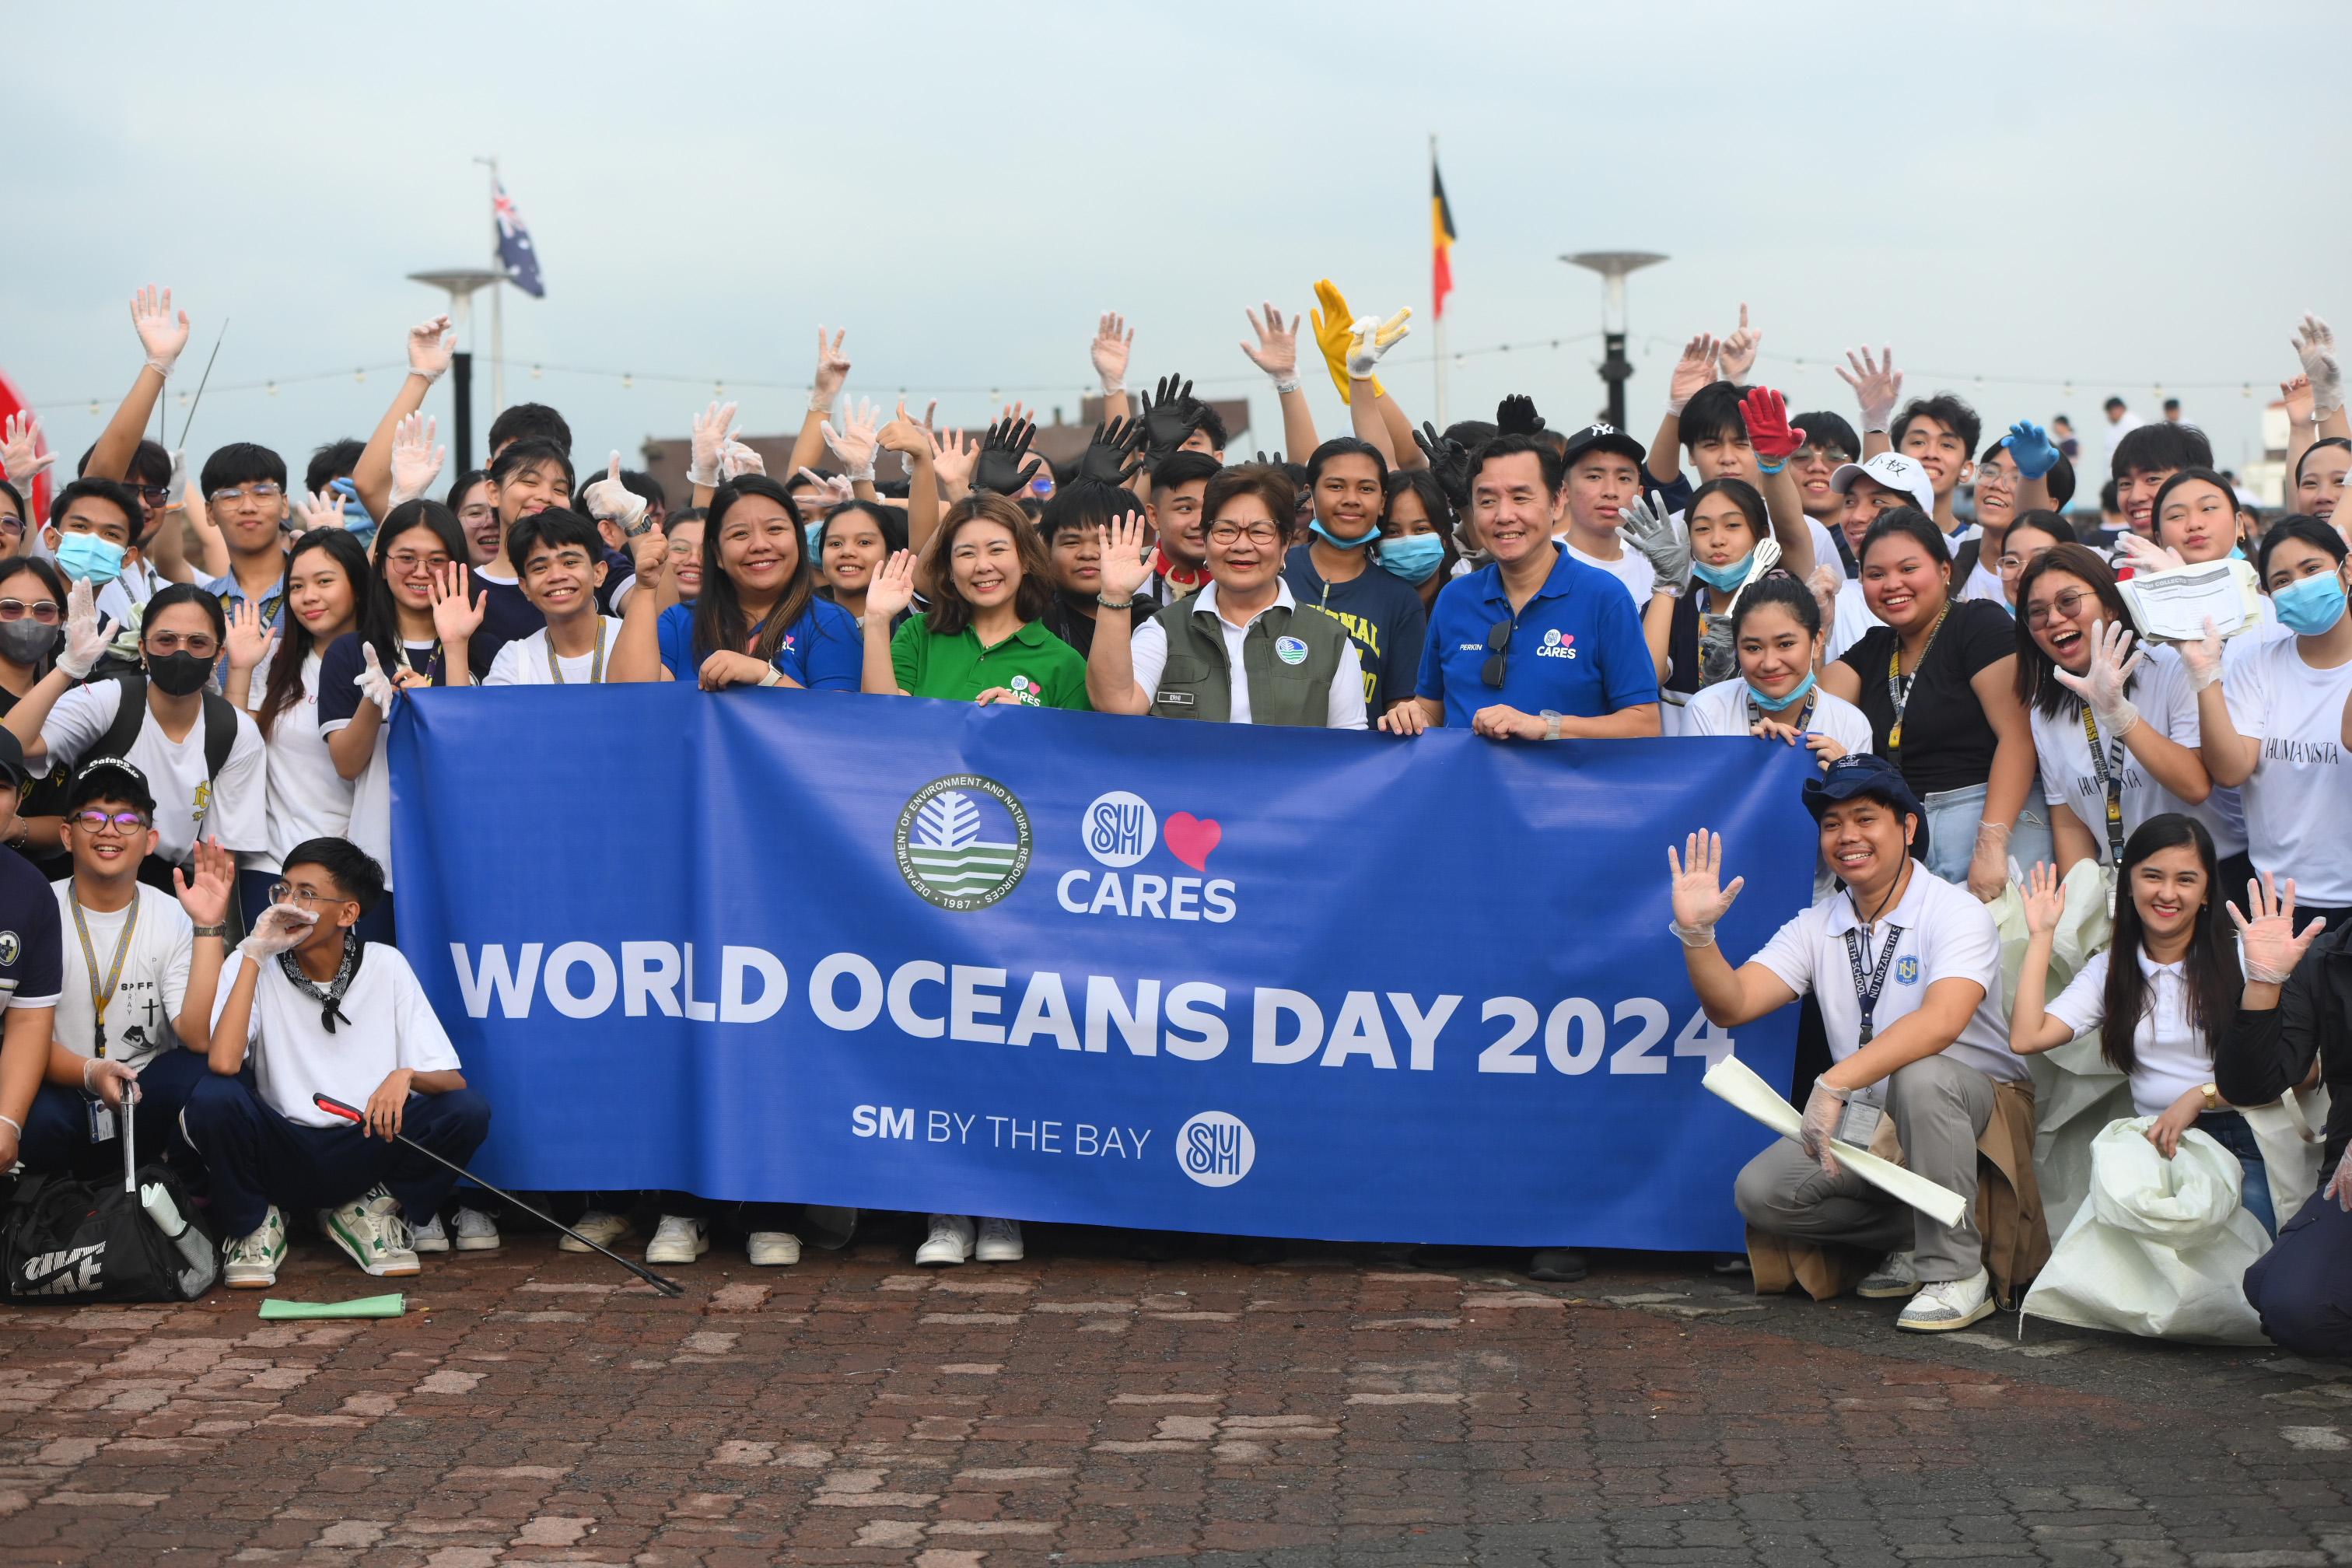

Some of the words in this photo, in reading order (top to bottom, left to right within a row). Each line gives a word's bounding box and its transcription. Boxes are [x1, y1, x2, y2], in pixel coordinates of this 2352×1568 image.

[1536, 646, 1577, 660] CARES
[1006, 688, 1041, 706] ARES
[2082, 706, 2099, 742] HUMSS
[2266, 737, 2338, 765] HUMANISTA
[908, 776, 982, 812] ENVIRONMENT
[983, 781, 1006, 798] AND
[901, 812, 912, 828] OF
[1004, 795, 1029, 845] NATURAL
[1090, 802, 1144, 856] SM
[897, 830, 931, 898] DEPARTMENT
[985, 847, 1029, 903] RESOURCES
[943, 898, 971, 909] 1987
[1056, 869, 1237, 924] CARES
[1874, 935, 1898, 983] NAZARETH
[1852, 961, 1867, 999] SCHOOL
[1869, 985, 1881, 999] NU
[450, 940, 789, 1024] WORLD
[808, 952, 1230, 1061] OCEANS
[1251, 987, 1464, 1071] DAY
[1478, 996, 1735, 1075] 2024
[852, 1104, 915, 1140] SM
[927, 1110, 975, 1145] BY
[985, 1115, 1062, 1153] THE
[1075, 1124, 1151, 1160] BAY
